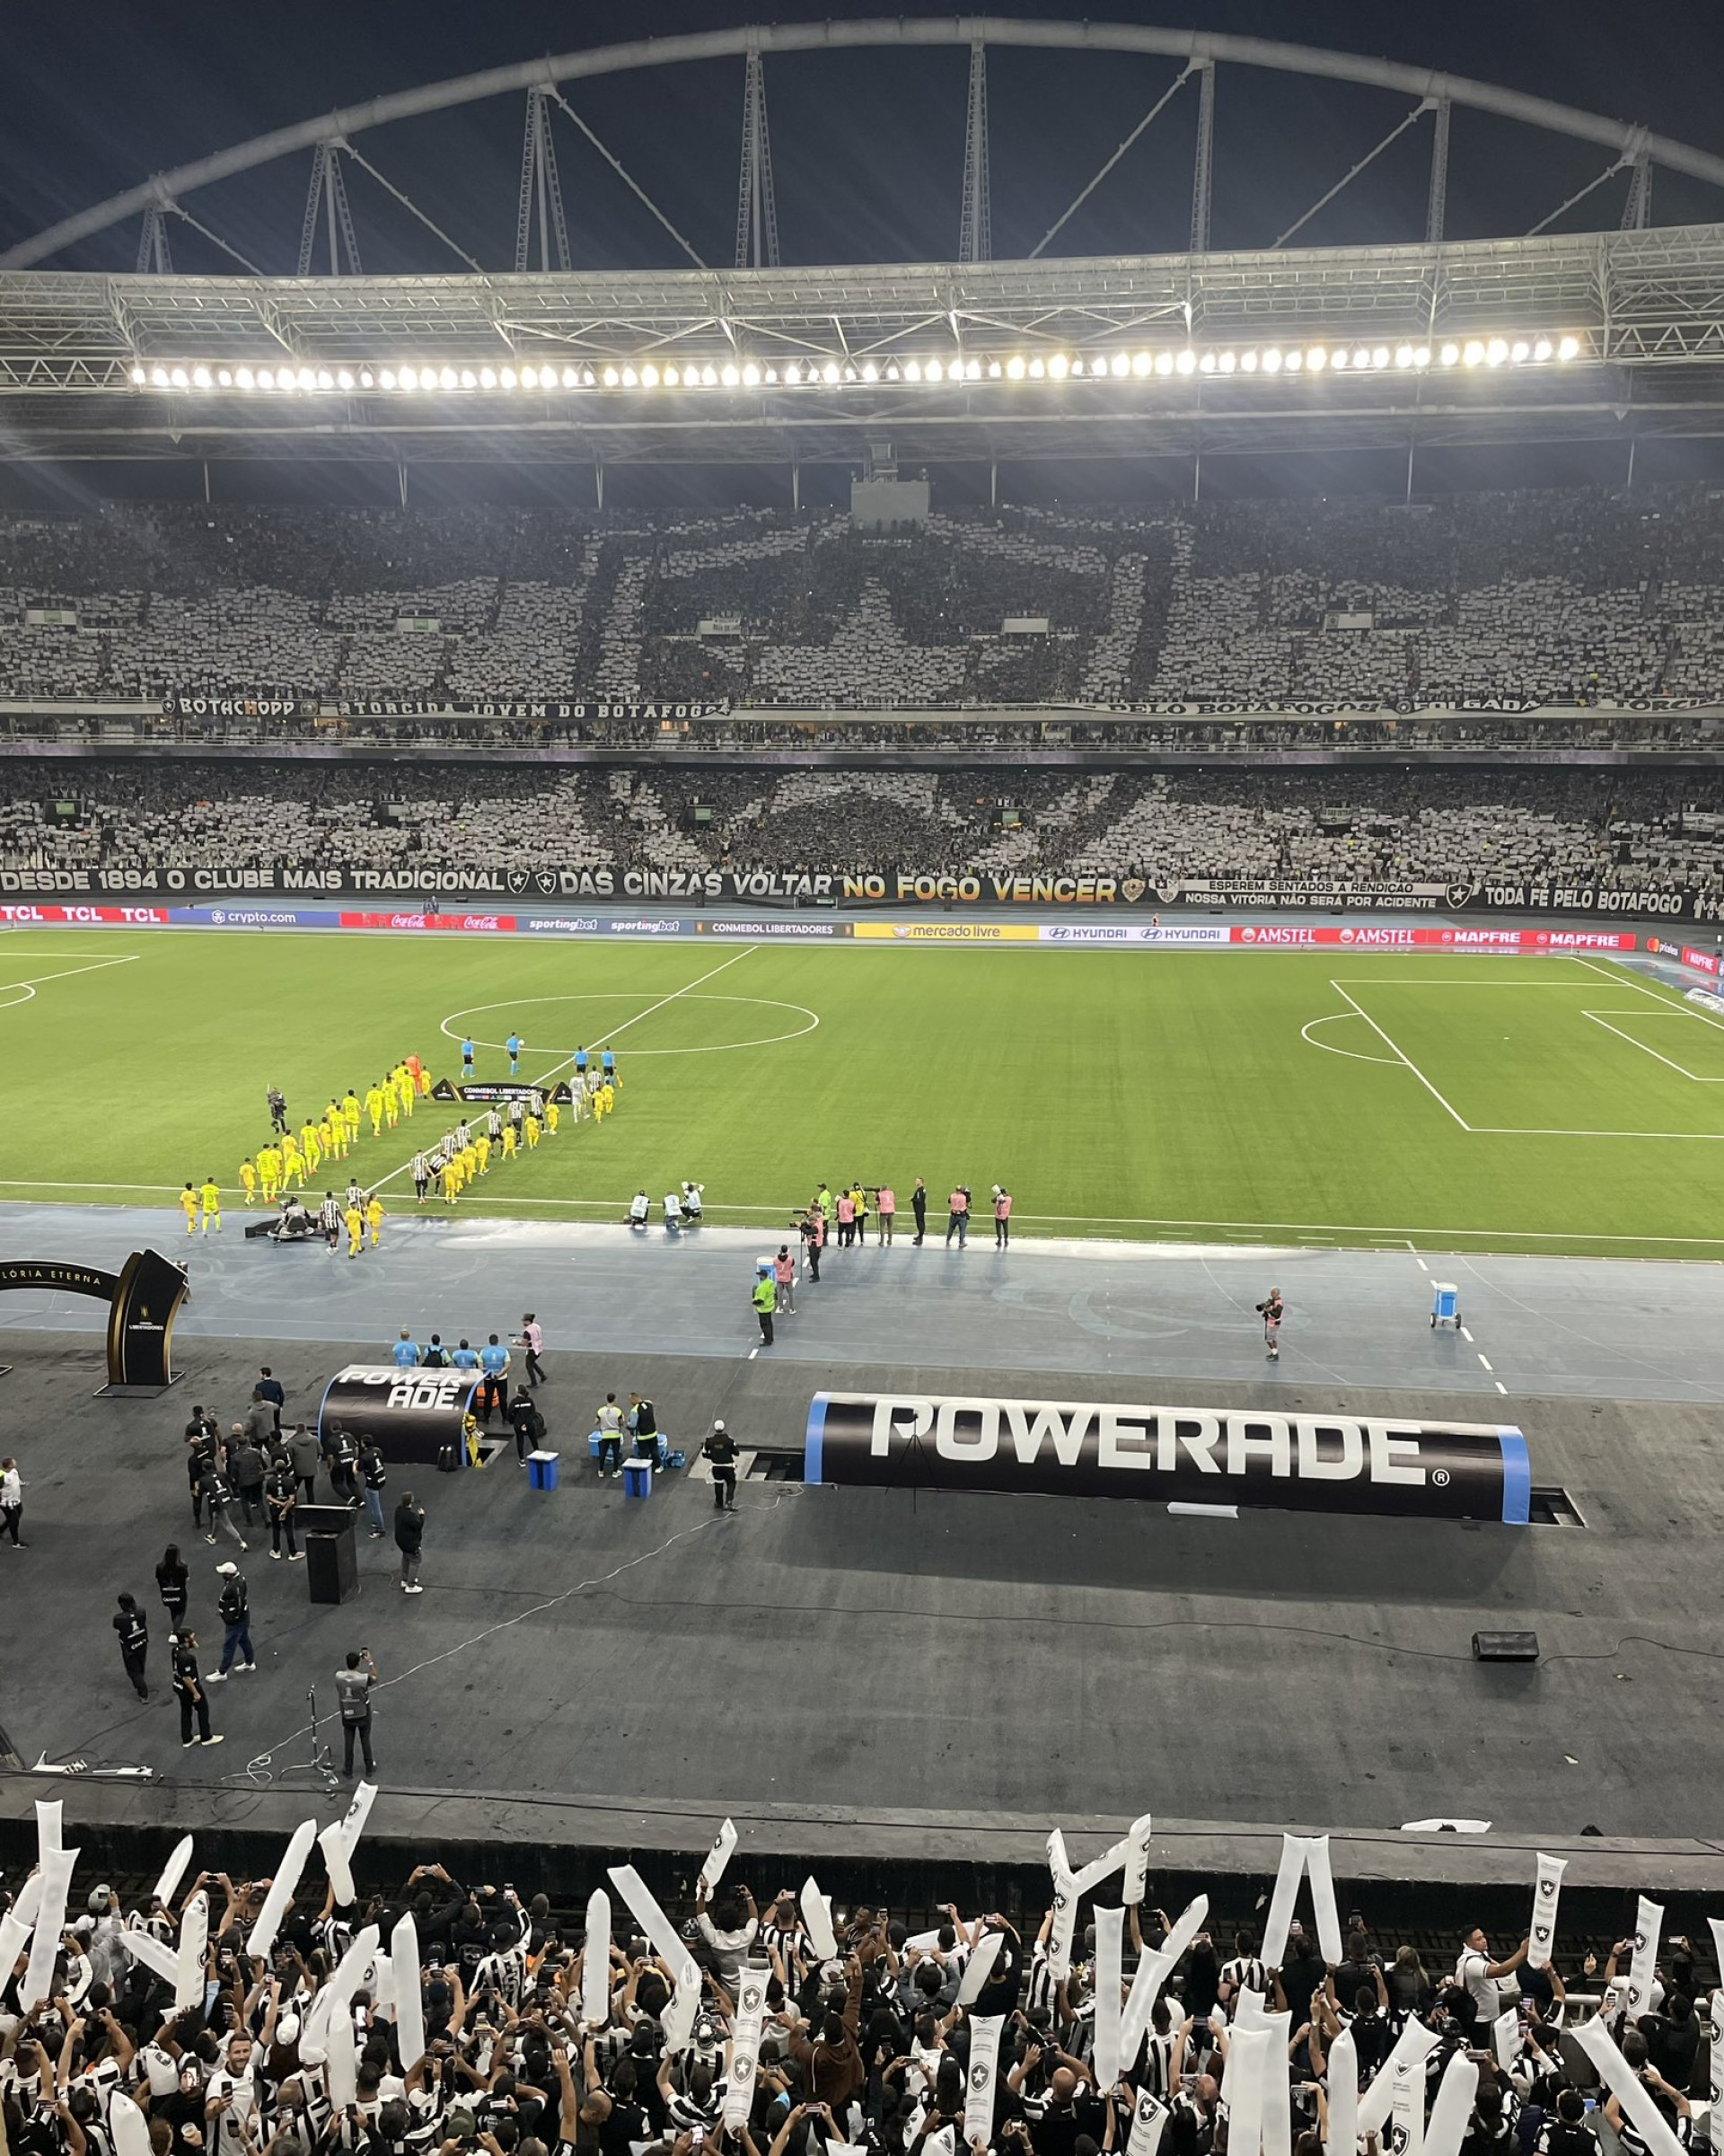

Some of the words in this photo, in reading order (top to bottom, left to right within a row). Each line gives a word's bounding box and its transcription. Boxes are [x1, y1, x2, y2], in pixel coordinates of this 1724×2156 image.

[354, 701, 455, 715] TORCIDA
[469, 703, 546, 717] JOVEM
[559, 704, 585, 717] DO
[597, 704, 717, 718] BOTAFOGO
[1196, 702, 1356, 715] BOTAFOGO
[1, 869, 91, 891] DESDE
[99, 869, 159, 890] 1894
[167, 870, 186, 889] O
[195, 869, 275, 889] CLUBE
[283, 870, 344, 890] MAIS
[350, 870, 505, 891] TRADICIONAL
[559, 872, 614, 894] DAS
[624, 872, 722, 896] CINZAS
[733, 874, 831, 896] VOLTAR
[843, 875, 885, 897] NO
[898, 876, 981, 901] FOGO
[992, 876, 1117, 902] VENCER
[1209, 880, 1264, 892] ESPEREM
[1270, 881, 1333, 892] SENTADOS
[1338, 882, 1346, 893] A
[1185, 893, 1227, 904] NOSSA
[1230, 892, 1276, 905] VITÓRIA
[1280, 893, 1306, 905] NÃO
[1309, 892, 1342, 906] SERÁ
[1347, 895, 1371, 906] POR
[1375, 896, 1437, 908] ACIDENTE
[1485, 886, 1525, 905] TODA
[1553, 889, 1593, 909] PELO
[1597, 891, 1682, 914] BOTAFOGO
[1, 906, 43, 920] TCL
[62, 907, 102, 921] TCL
[121, 908, 161, 922] TCL
[228, 911, 296, 924] crypto.com
[530, 918, 597, 931] sportingbet
[611, 919, 680, 933] sportingbet
[712, 922, 764, 933] CONMEBOL
[765, 923, 833, 935] LIBERTADORES
[913, 925, 971, 937] mercado
[973, 925, 1000, 937] livre
[1073, 928, 1127, 939] HYUNDAI
[1165, 929, 1220, 940] HYUNDAI
[1257, 928, 1315, 943] AMSTEL
[1356, 928, 1414, 944] AMSTEL
[1454, 931, 1521, 944] MAPFRE
[1550, 933, 1620, 947] MAPFRE
[50, 1270, 101, 1286] ETERNA
[339, 1370, 462, 1388] POWER
[386, 1385, 456, 1412] ADE
[870, 1398, 1427, 1486] POWERADE
